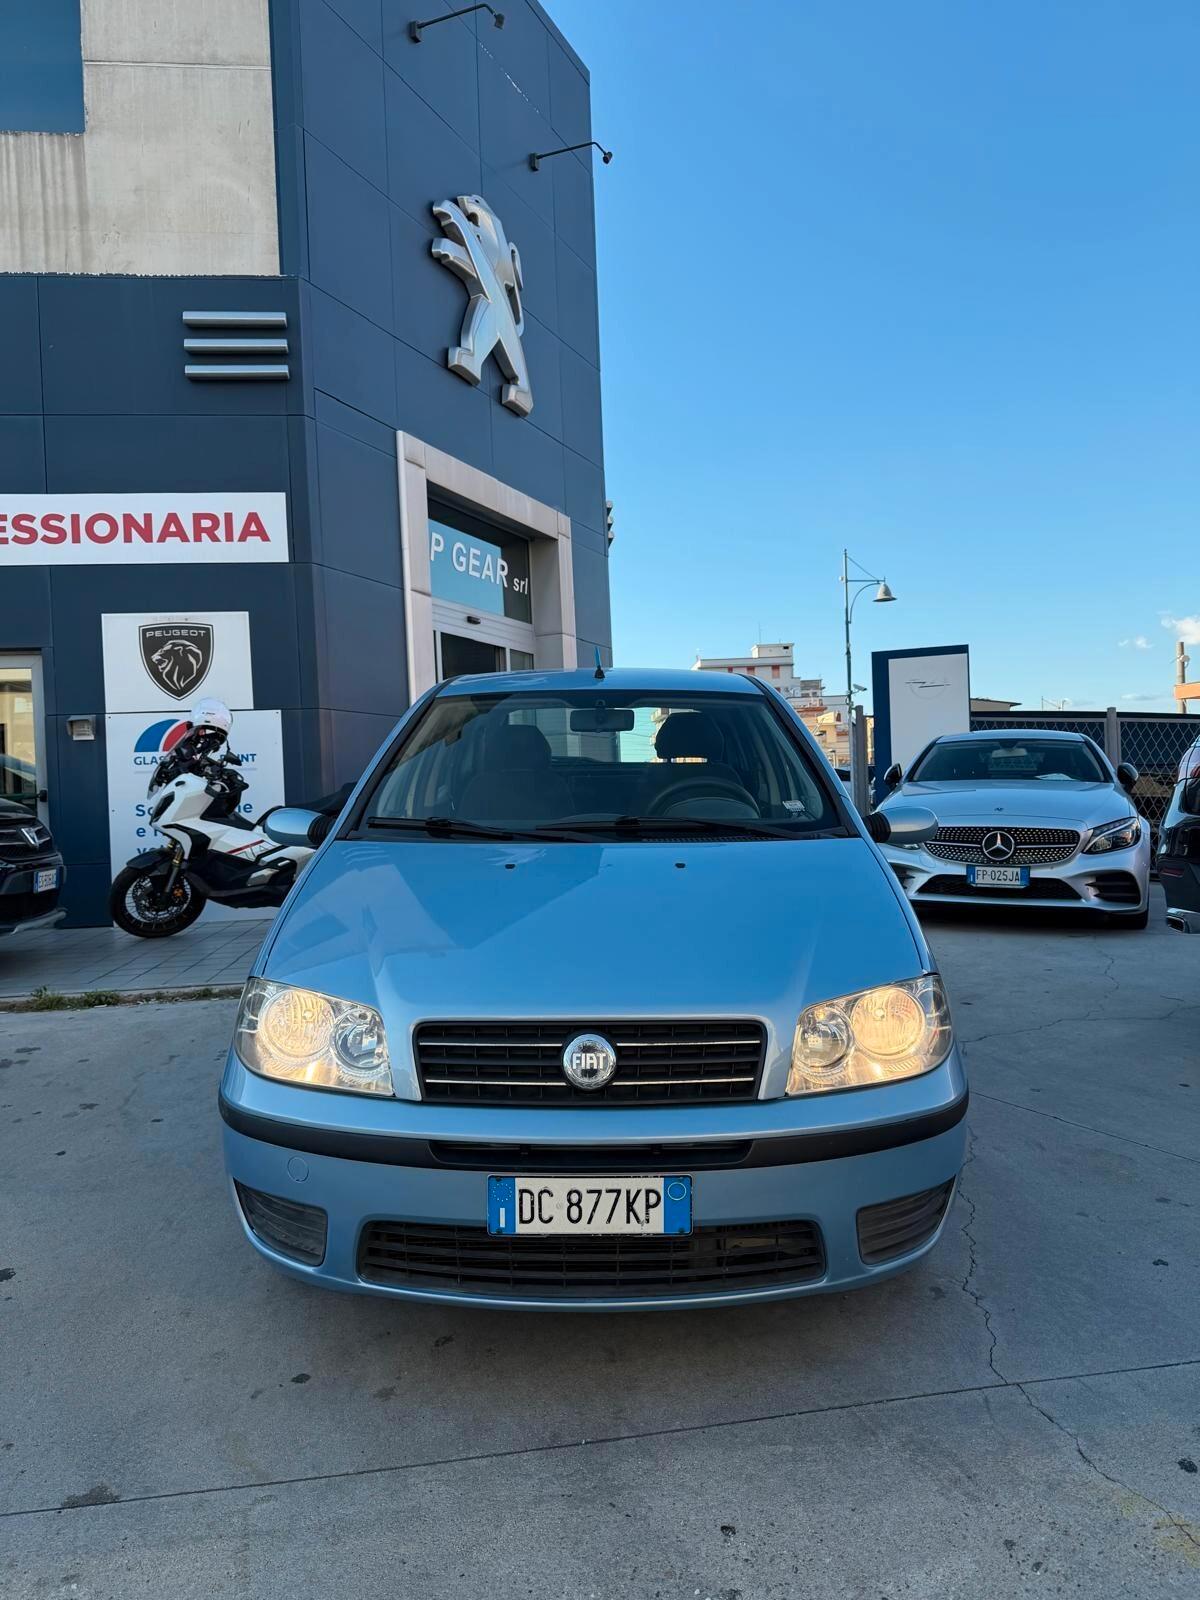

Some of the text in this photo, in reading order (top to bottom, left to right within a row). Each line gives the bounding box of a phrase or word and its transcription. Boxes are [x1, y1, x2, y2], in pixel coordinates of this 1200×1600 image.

[452, 541, 509, 588] GEAR
[513, 577, 529, 595] srl
[146, 629, 207, 638] PEUGEOT
[572, 1052, 607, 1070] FIAT
